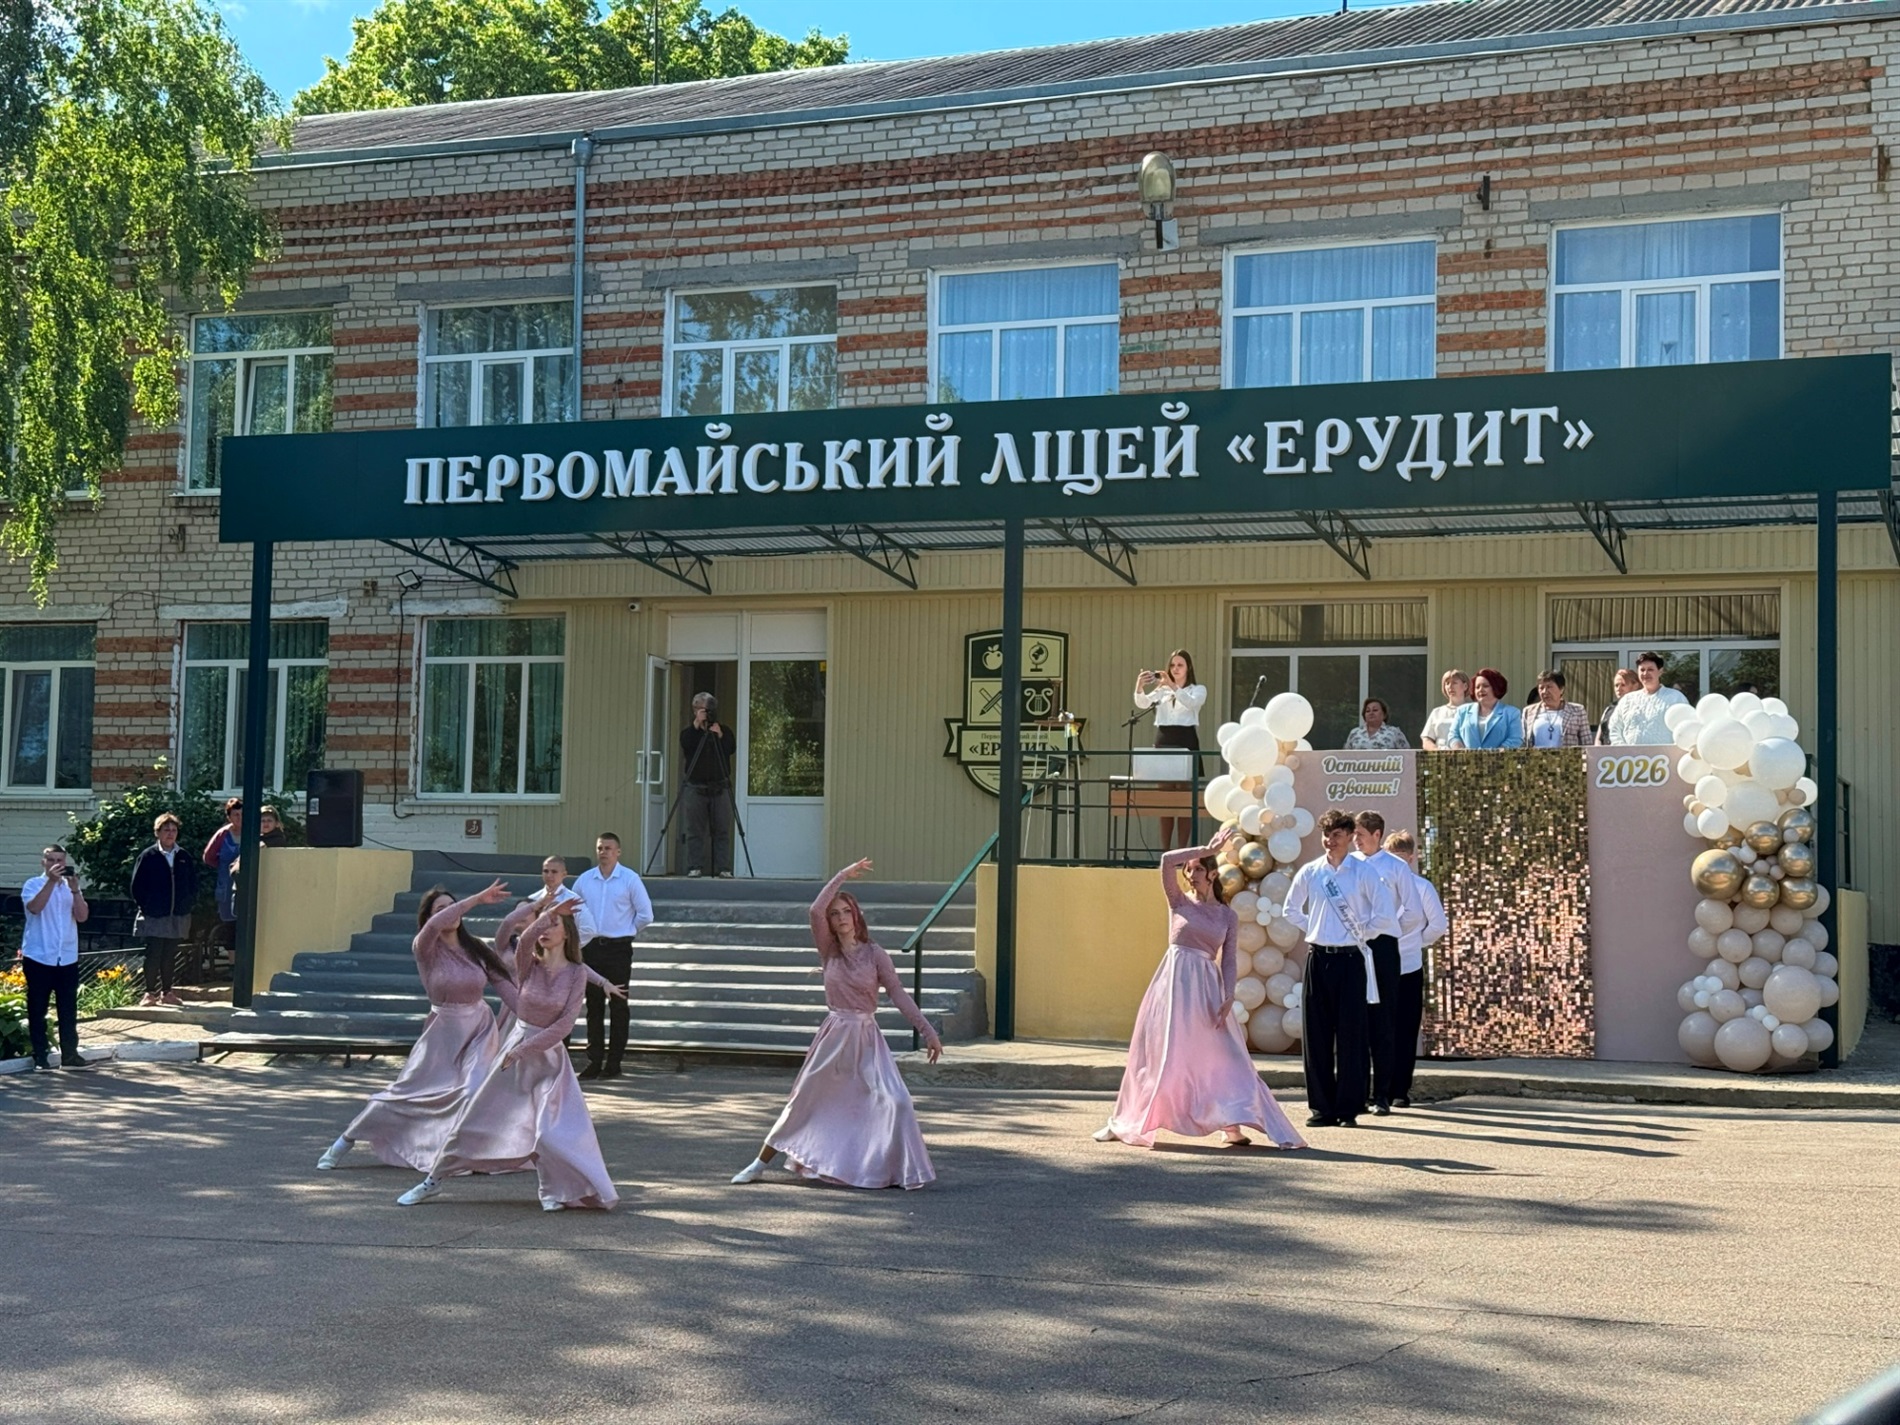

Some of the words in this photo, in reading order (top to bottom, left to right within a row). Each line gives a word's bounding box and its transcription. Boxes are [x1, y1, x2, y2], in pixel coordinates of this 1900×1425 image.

[403, 413, 961, 505] ПЕРВОМАЙСЬКИЙ
[980, 401, 1201, 496] ЛІЦЕЙ
[1226, 405, 1595, 481] «ЕРУДИТ»
[1323, 756, 1402, 773] Останній
[1598, 757, 1668, 785] 2026
[1328, 776, 1400, 799] дзвоник!
